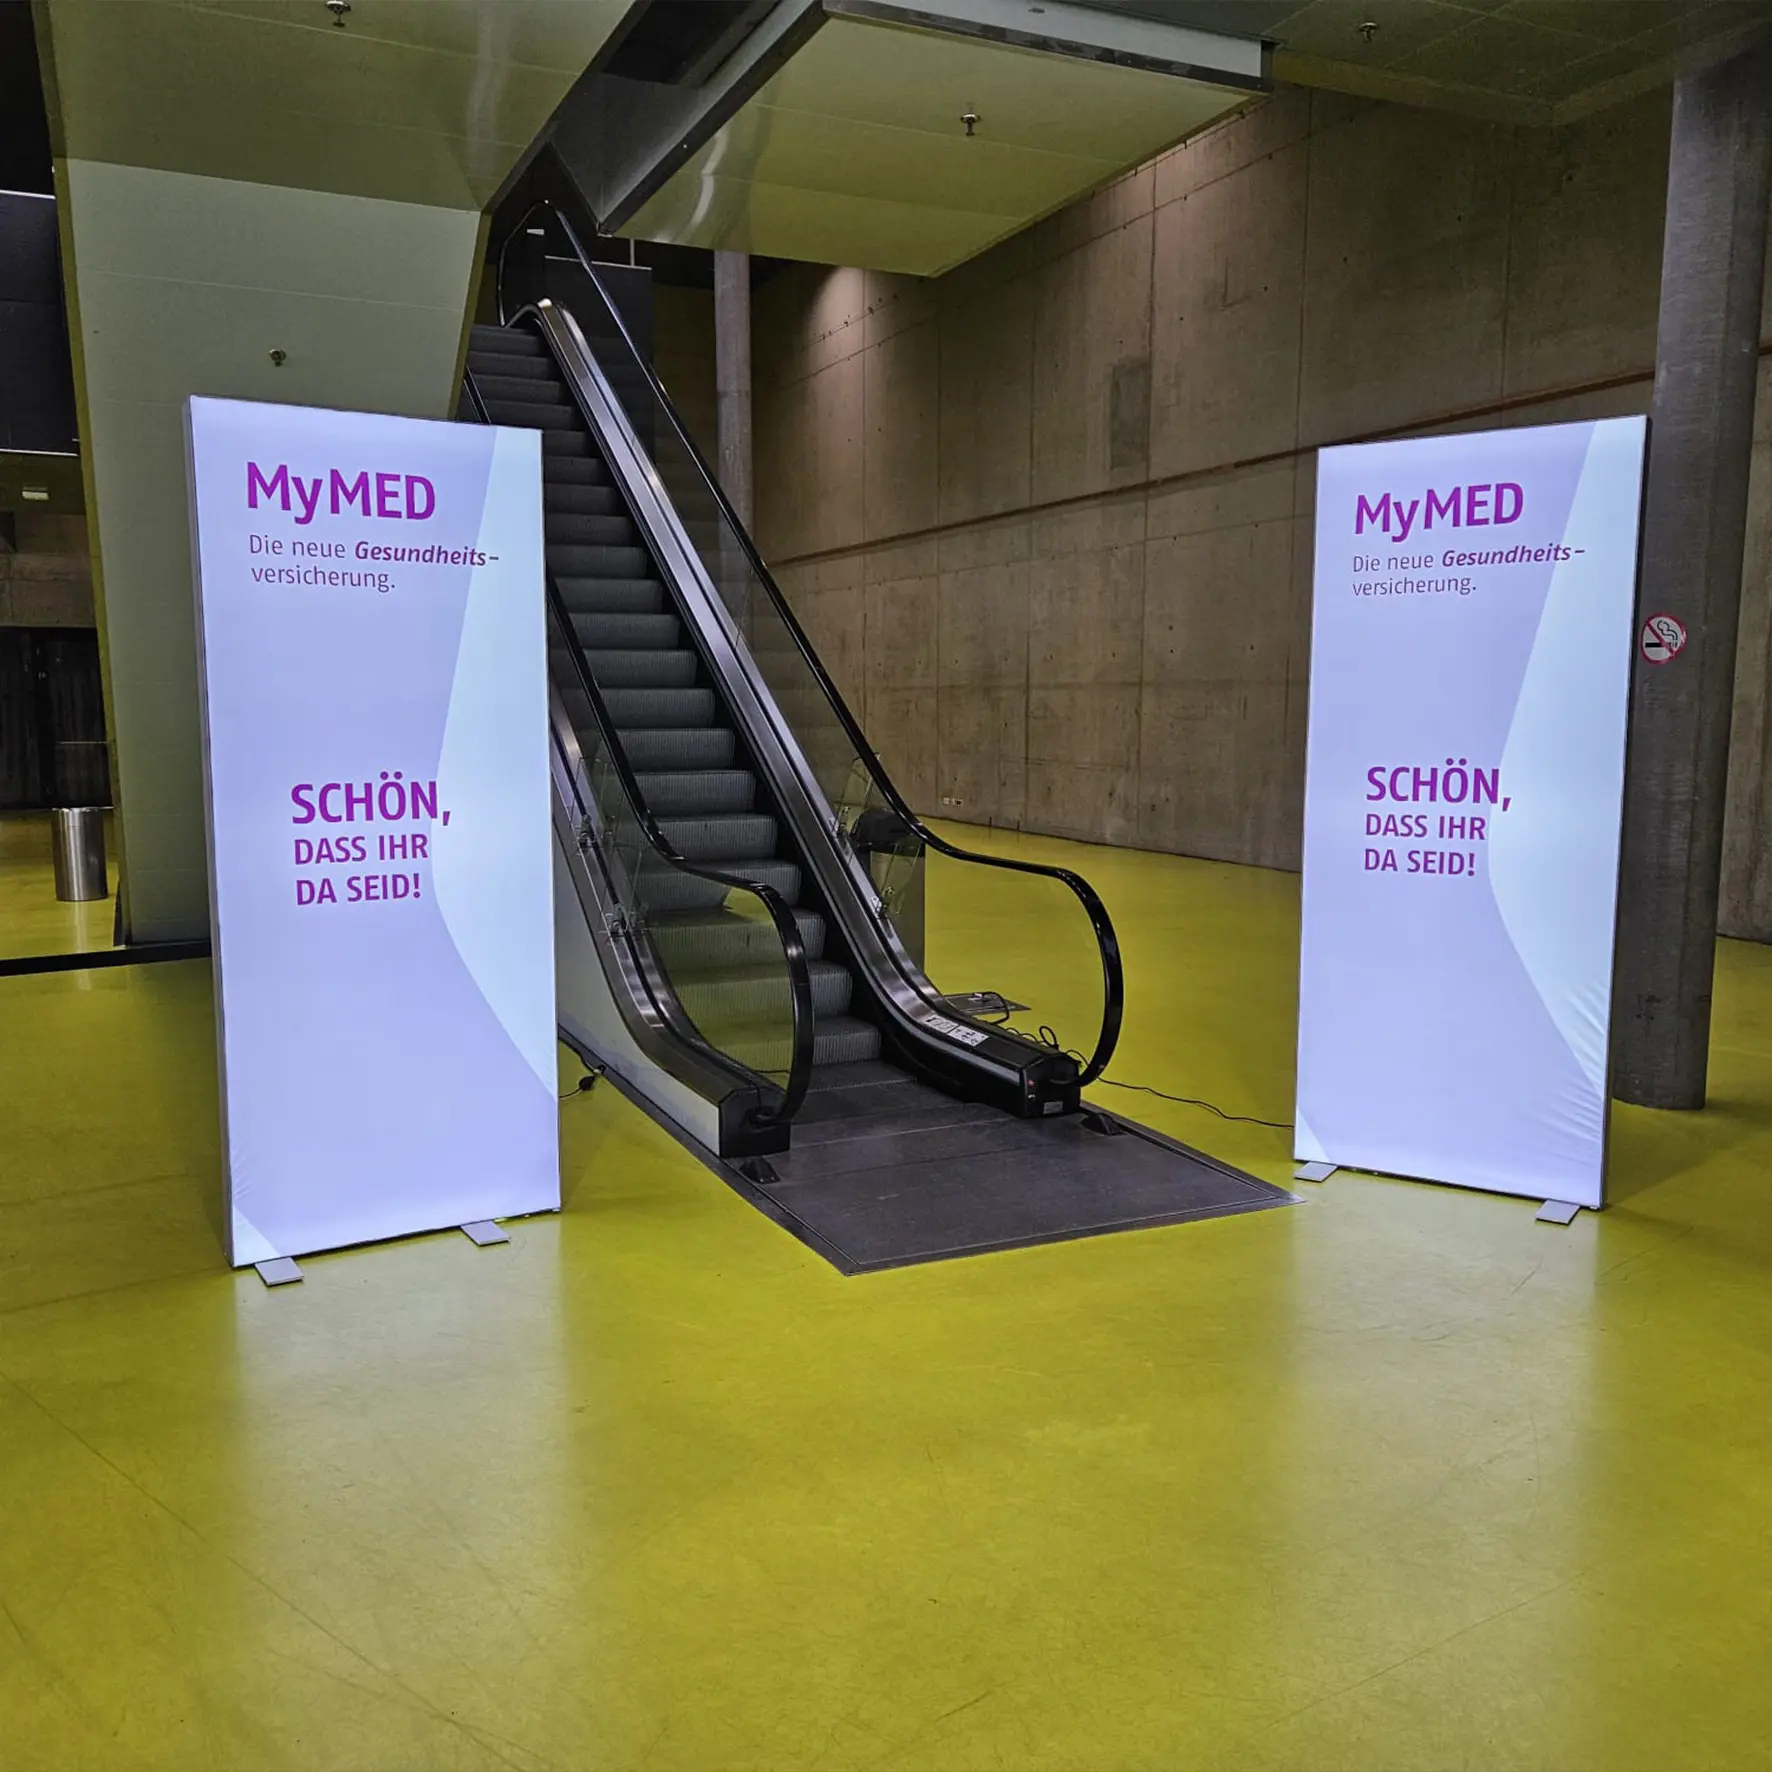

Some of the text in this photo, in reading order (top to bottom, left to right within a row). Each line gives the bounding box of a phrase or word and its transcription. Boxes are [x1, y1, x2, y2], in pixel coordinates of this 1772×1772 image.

[246, 461, 436, 526] MyMED
[1354, 482, 1524, 544] MyMED
[249, 534, 500, 567] Die neue Gesundheits-
[1353, 542, 1586, 573] Die neue Gesundheits-
[250, 566, 396, 594] versicherung.
[1352, 576, 1477, 597] versicherung.
[290, 770, 451, 827] SCHÖN,
[1366, 757, 1512, 813] SCHÖN,
[1365, 813, 1487, 841] DASS IHR
[293, 832, 429, 866] DASS IHR
[1364, 847, 1476, 877] DA SEID!
[295, 872, 422, 906] DA SEID!
